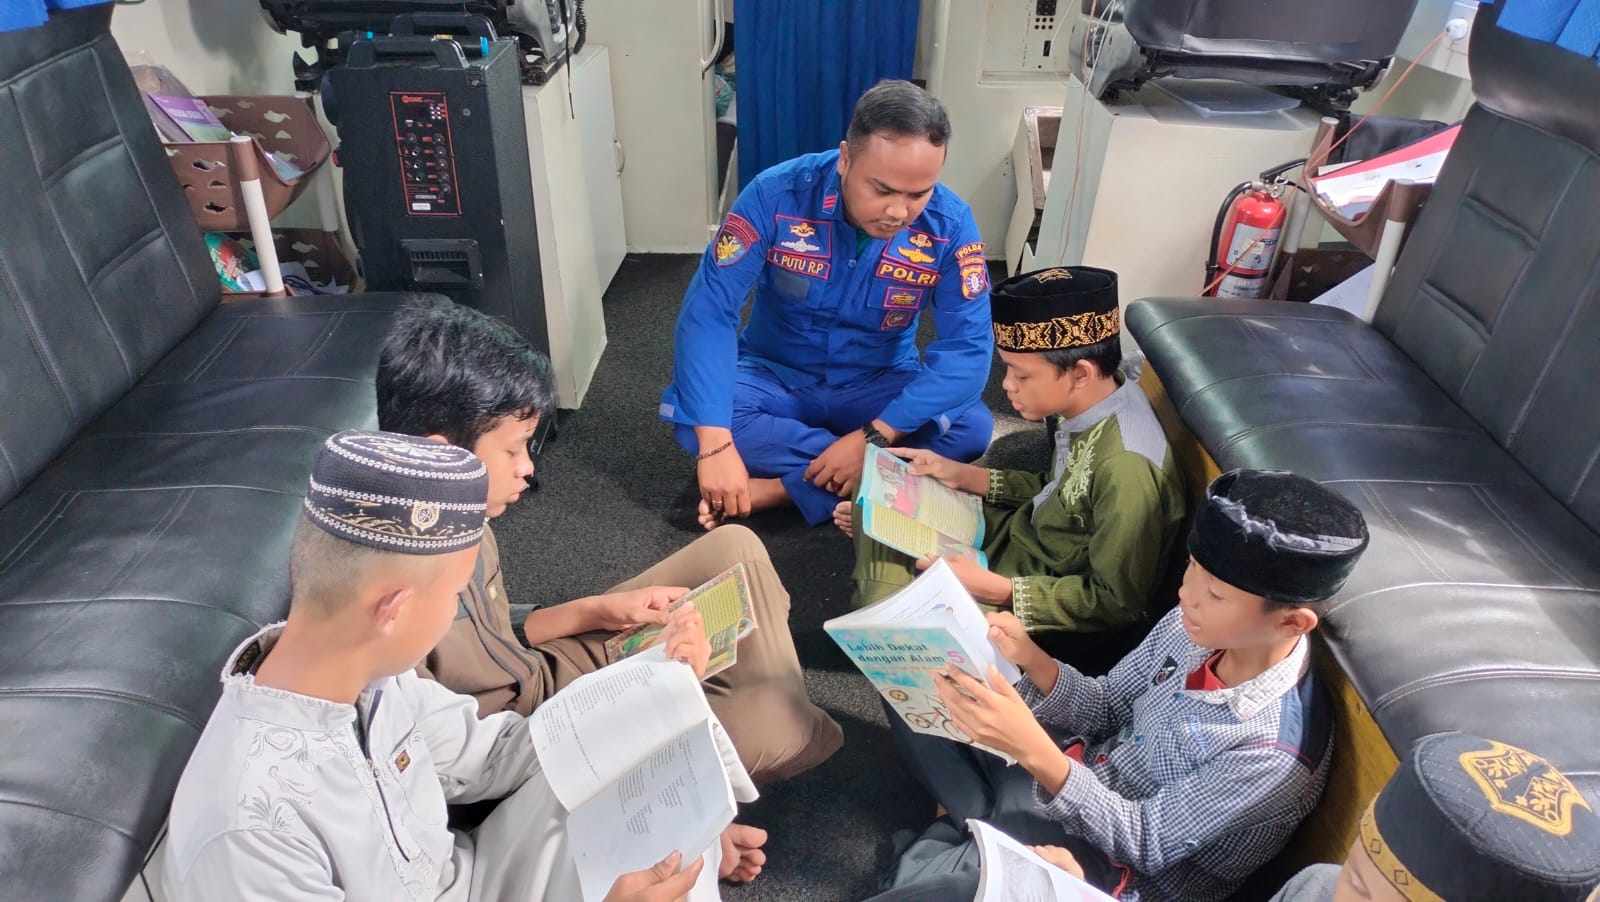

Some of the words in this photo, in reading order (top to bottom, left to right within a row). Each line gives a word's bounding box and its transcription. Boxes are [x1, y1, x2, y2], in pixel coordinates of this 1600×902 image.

[958, 244, 982, 257] POLDA
[781, 255, 806, 270] PUTU
[880, 264, 937, 284] POLRI
[847, 643, 884, 652] Lebih
[887, 643, 929, 652] Dekat
[858, 654, 905, 664] dengan
[911, 655, 945, 663] Alam
